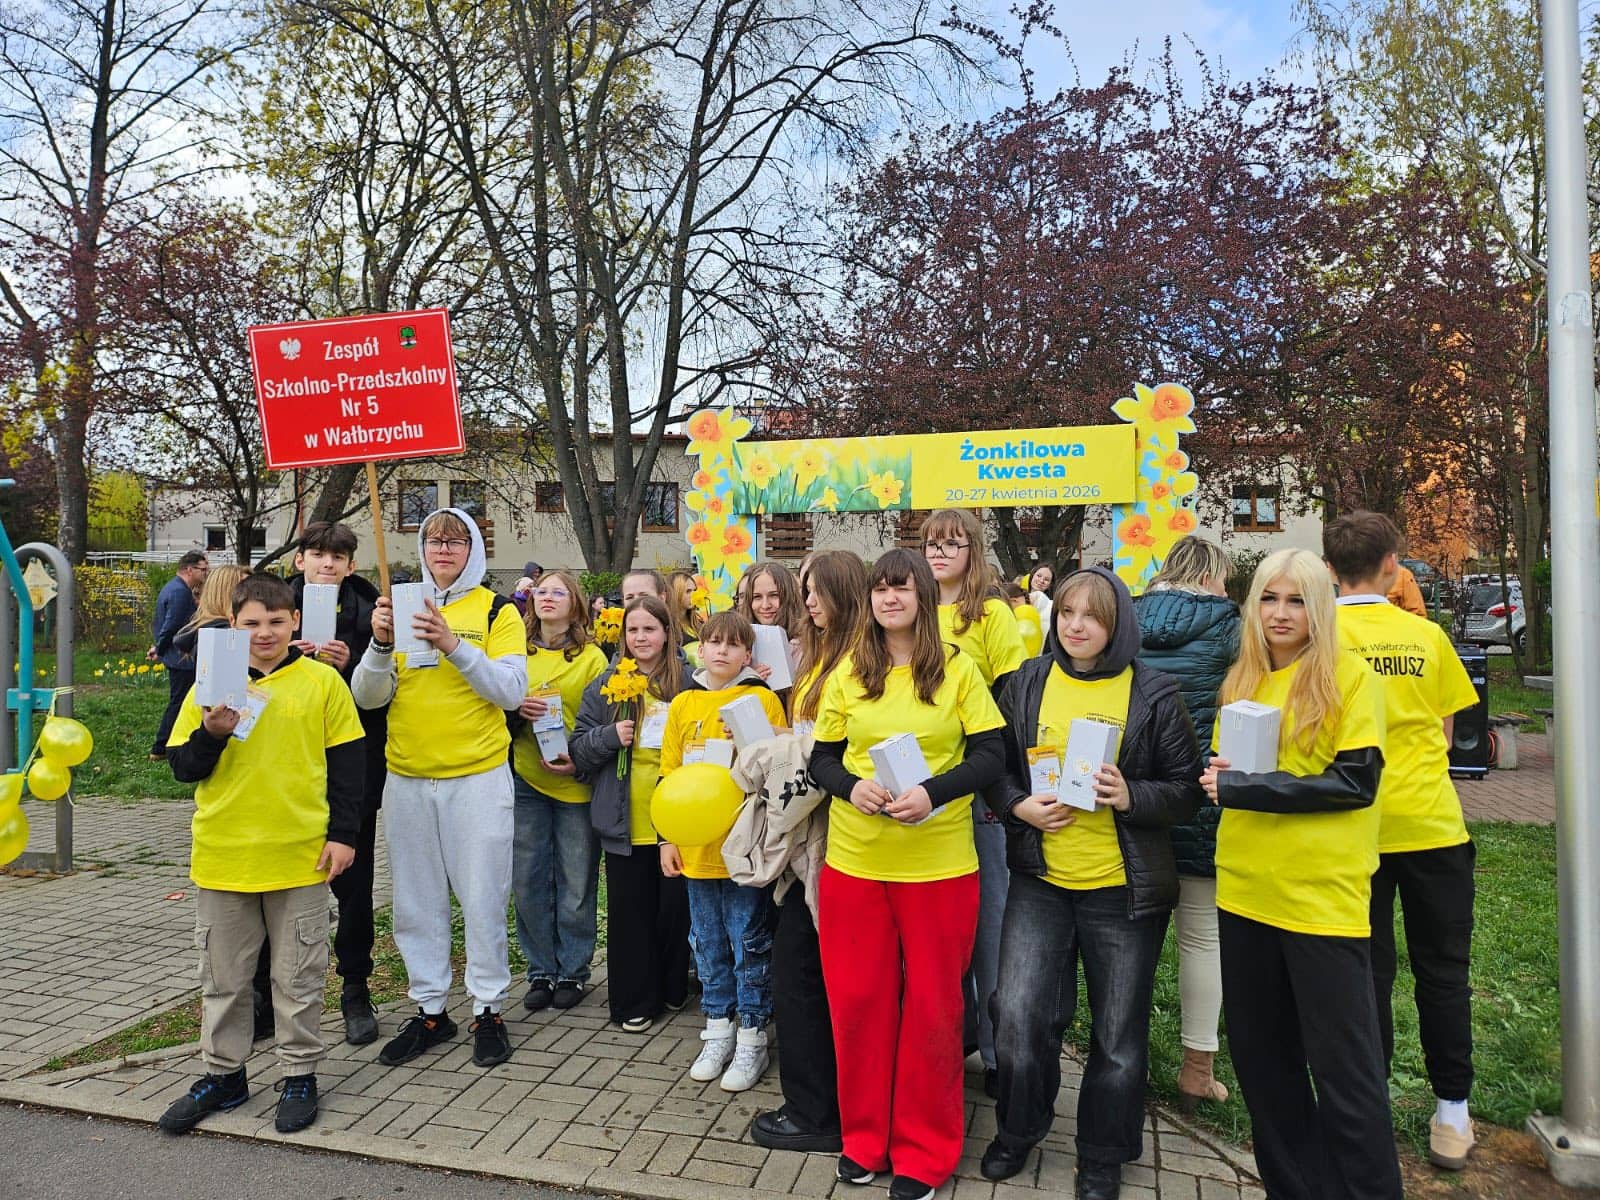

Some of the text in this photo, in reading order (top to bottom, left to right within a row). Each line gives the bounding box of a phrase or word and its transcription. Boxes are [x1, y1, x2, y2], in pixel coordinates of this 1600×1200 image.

[323, 336, 380, 362] Zespół
[263, 364, 447, 399] Szkolno-Przedszkolny
[340, 395, 379, 417] Nr 5
[304, 421, 424, 448] w Wałbrzychu
[959, 438, 1085, 461] Żonkilowa
[978, 462, 1066, 480] Kwesta
[945, 484, 1101, 501] 20-27 kwietnia 2026
